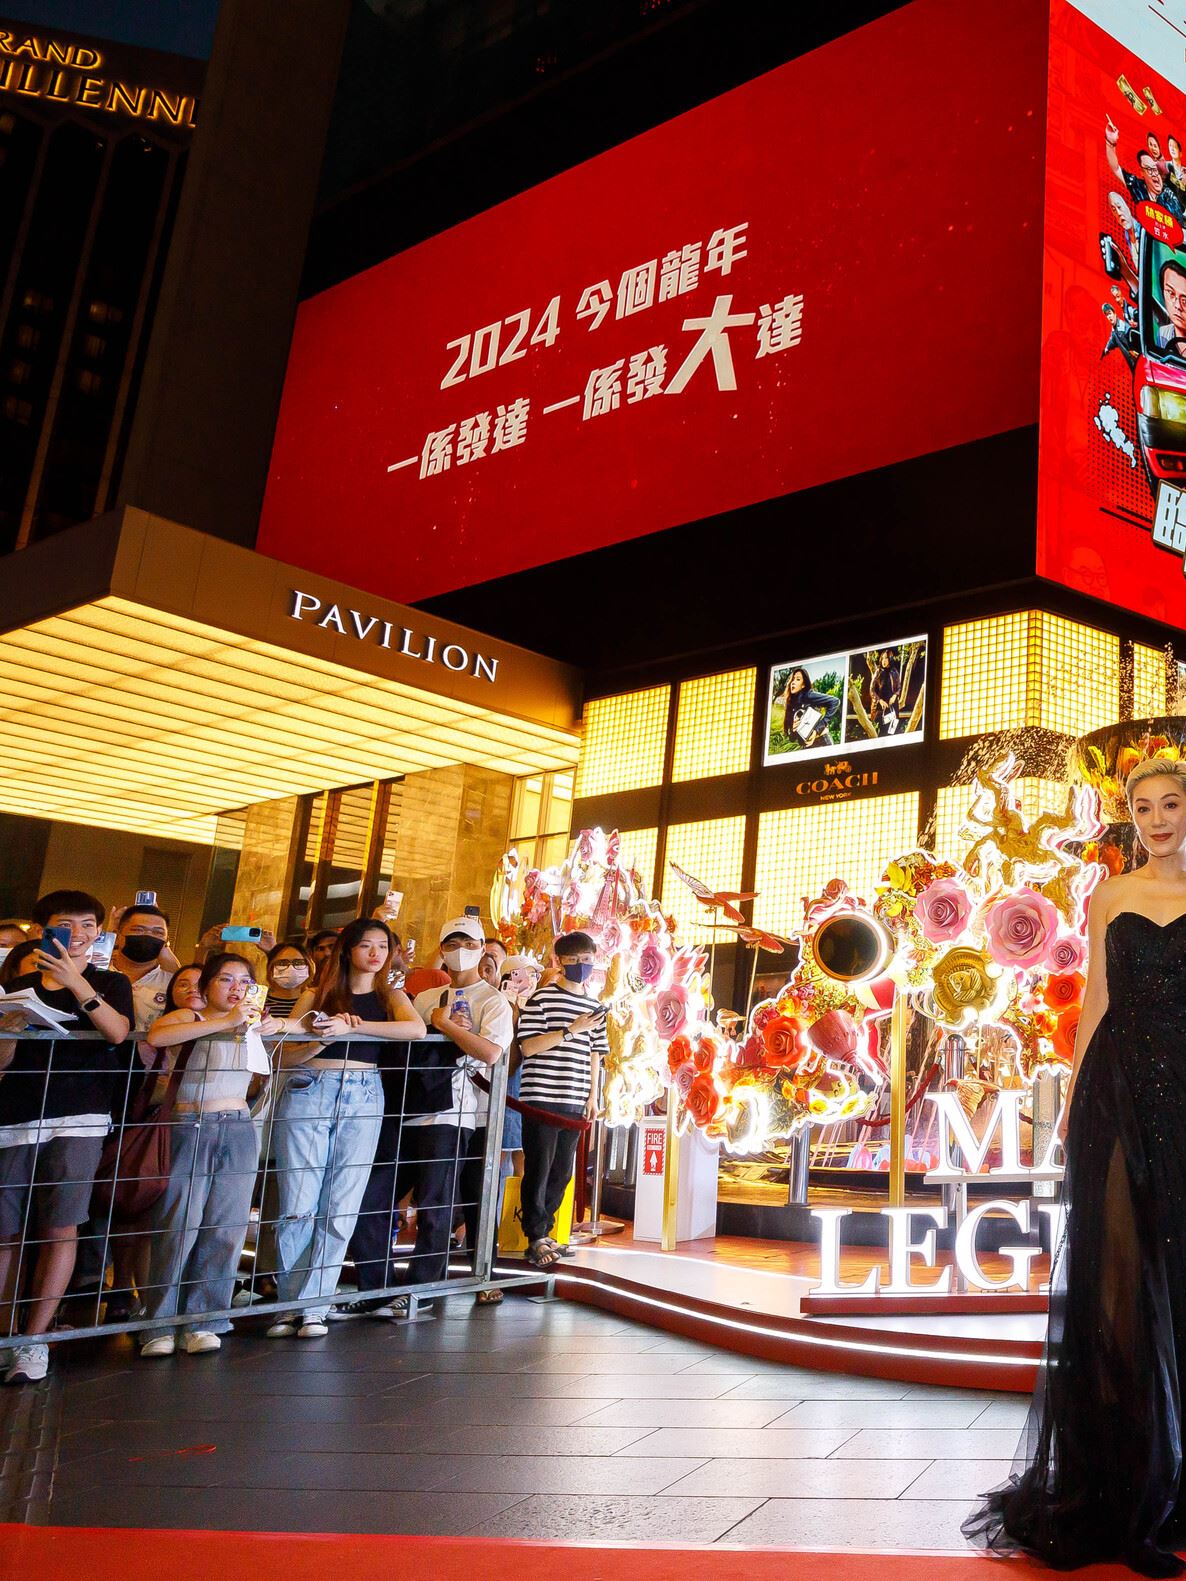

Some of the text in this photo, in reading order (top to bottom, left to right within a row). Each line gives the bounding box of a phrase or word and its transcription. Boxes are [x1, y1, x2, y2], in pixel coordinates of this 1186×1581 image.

[440, 222, 749, 390] 2024 今個龍年
[387, 398, 530, 480] 一係發達
[290, 589, 500, 683] PAVILION
[795, 771, 879, 795] COACH
[647, 1133, 663, 1145] FIRE
